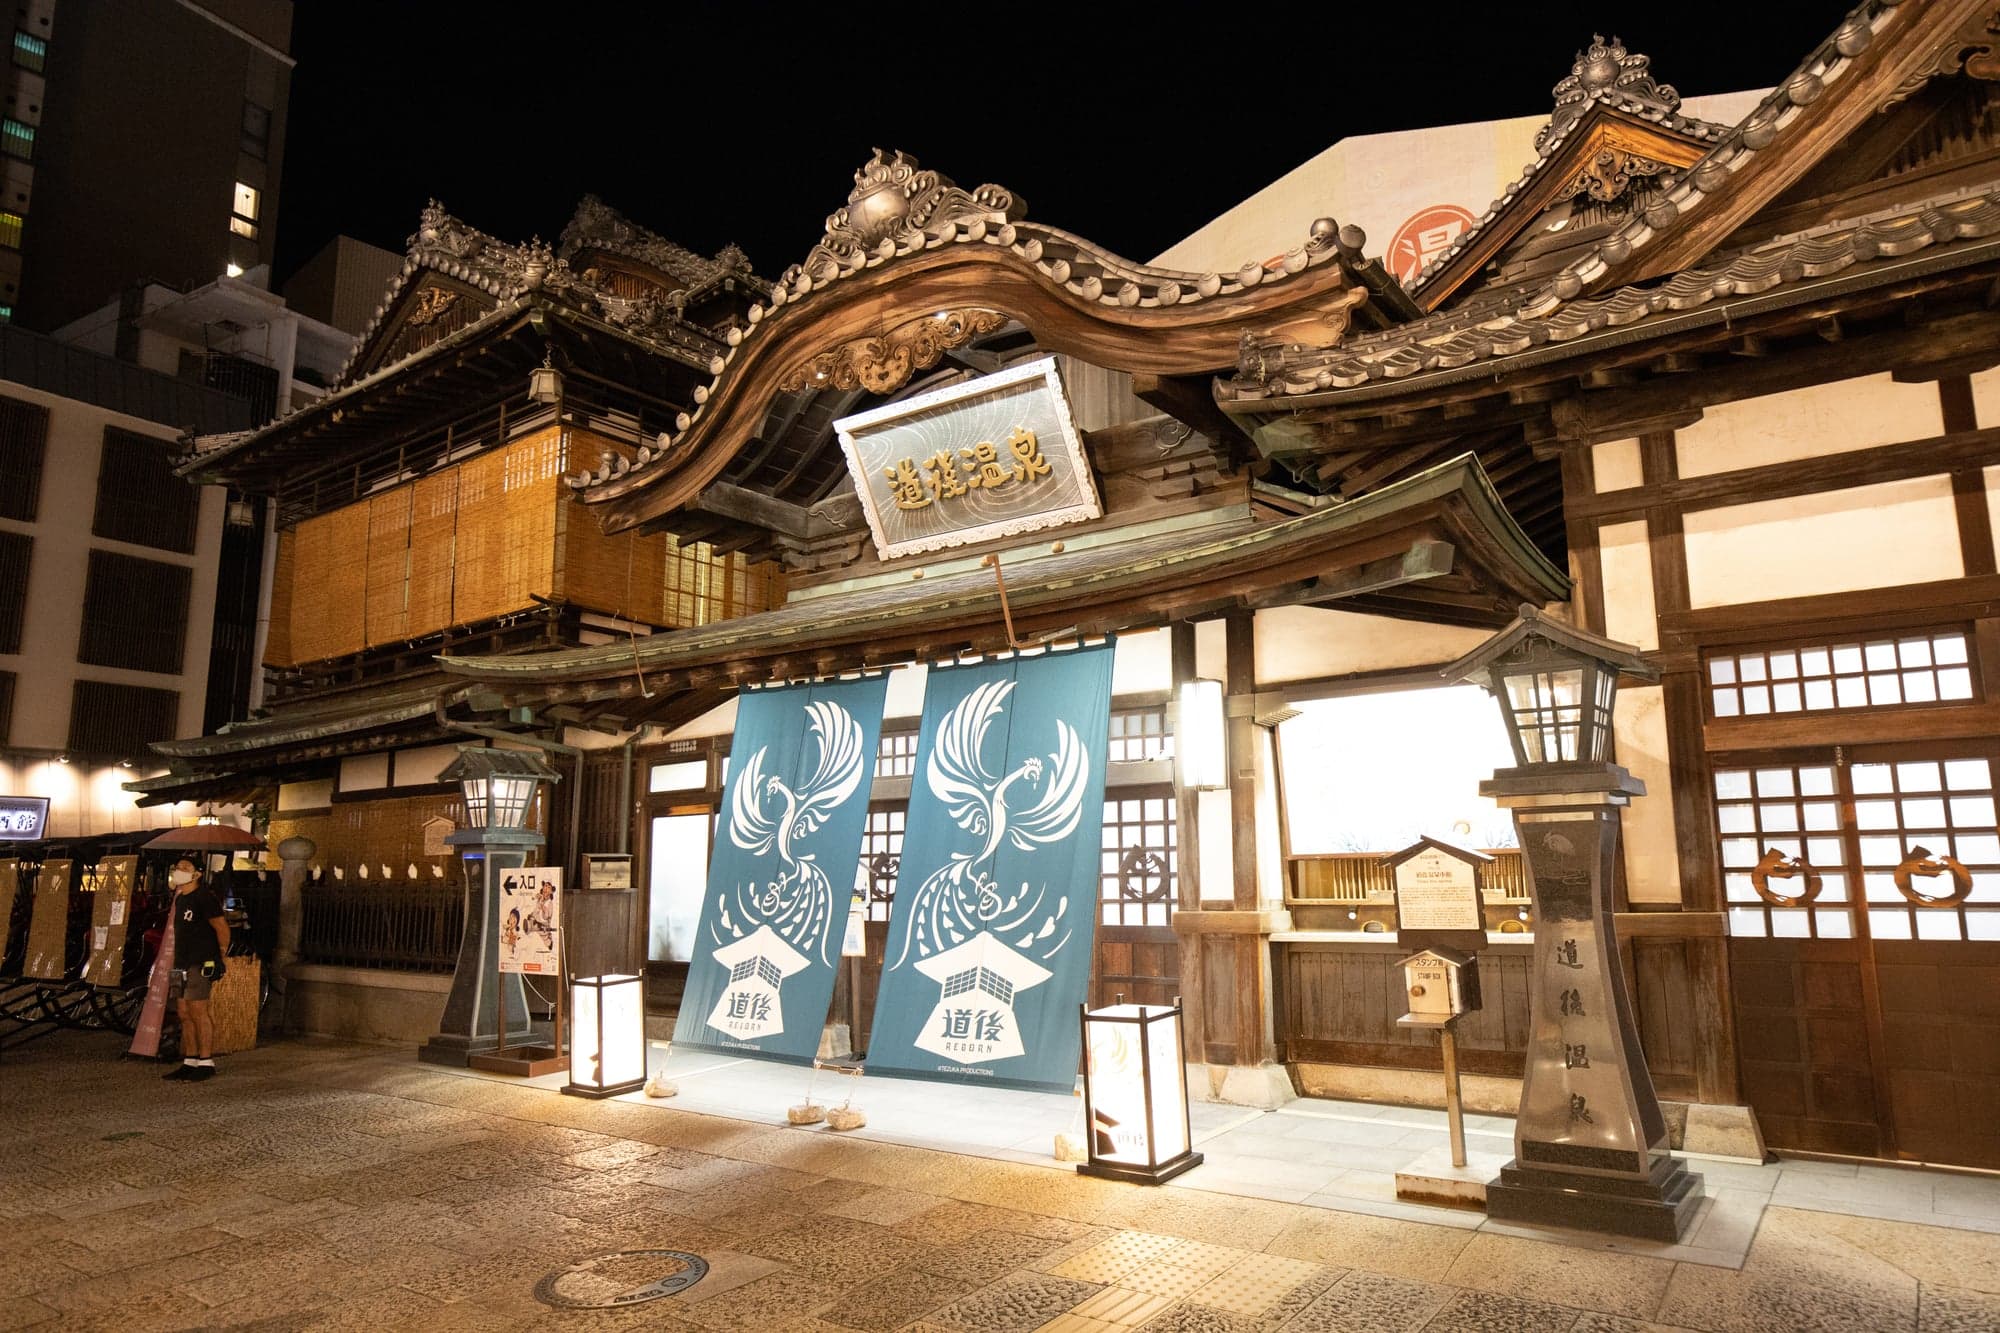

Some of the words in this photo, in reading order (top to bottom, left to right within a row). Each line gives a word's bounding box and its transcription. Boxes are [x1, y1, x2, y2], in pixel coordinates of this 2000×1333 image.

[1399, 219, 1463, 288] 温
[883, 425, 1052, 511] 道後温泉
[519, 874, 536, 890] 入口
[726, 992, 774, 1021] 道後
[729, 1021, 762, 1032] REBORN
[941, 1008, 1005, 1041] 道後
[1556, 938, 1594, 1125] 道後温泉
[945, 1042, 993, 1053] REBORN
